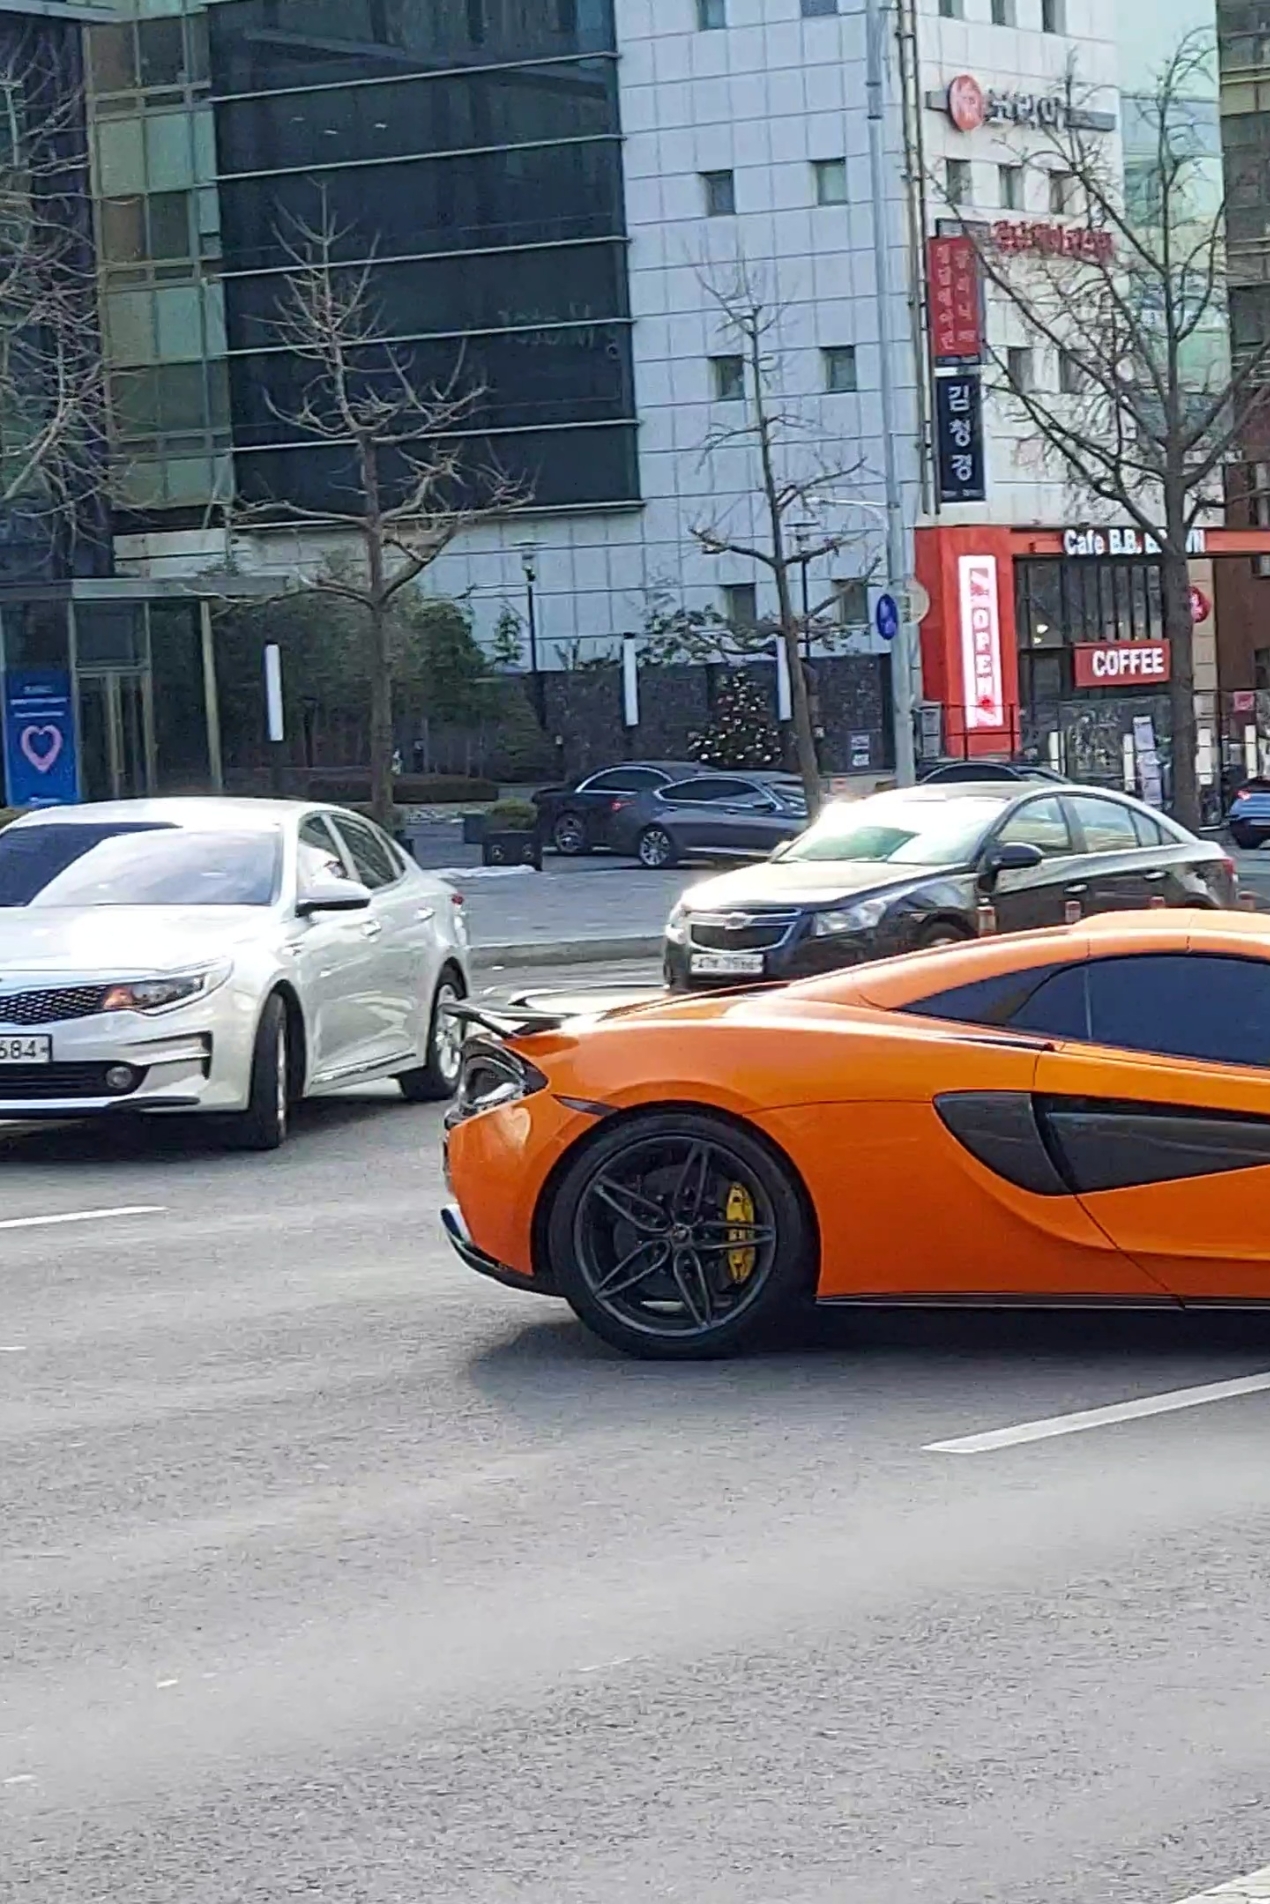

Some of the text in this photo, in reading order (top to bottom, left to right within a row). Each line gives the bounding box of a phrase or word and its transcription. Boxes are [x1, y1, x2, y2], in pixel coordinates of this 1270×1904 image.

[948, 384, 972, 481] 김청경
[1064, 529, 1106, 556] Cafe
[1092, 647, 1165, 678] COFFEE
